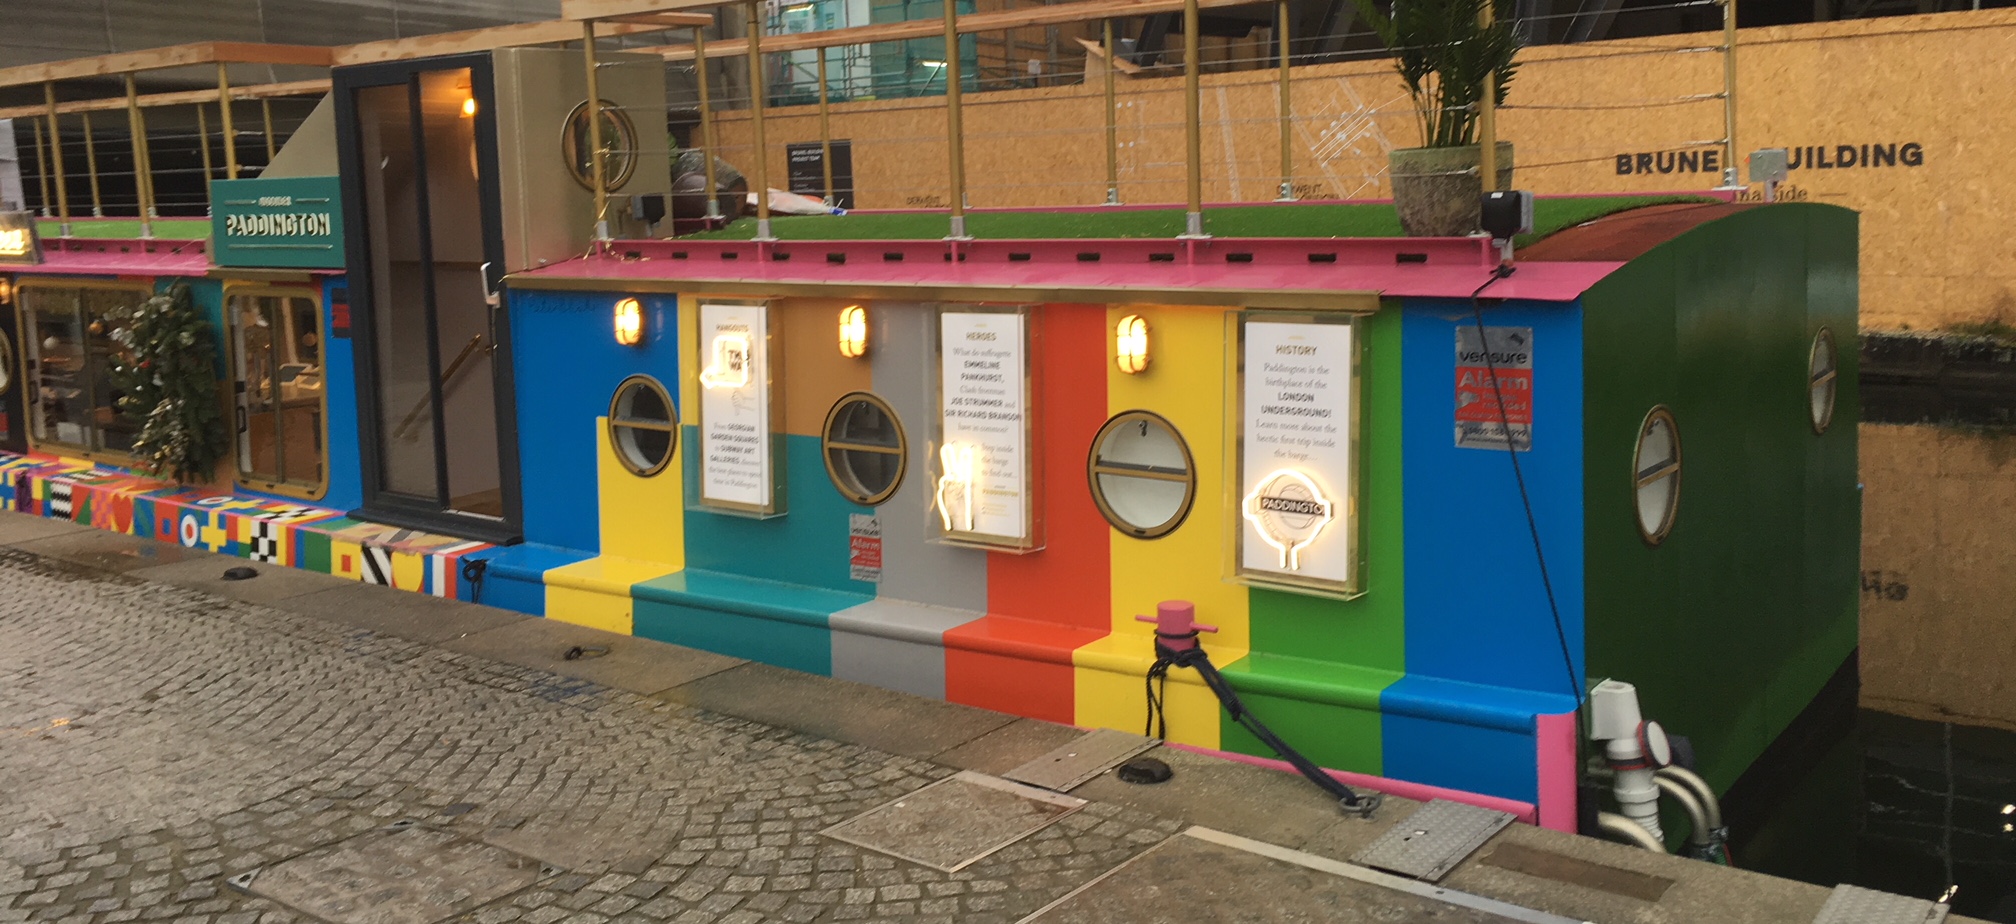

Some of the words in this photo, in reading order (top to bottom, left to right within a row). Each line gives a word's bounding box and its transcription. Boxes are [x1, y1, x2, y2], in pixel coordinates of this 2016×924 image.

[1615, 150, 1721, 175] BRUNE
[1759, 142, 1924, 169] UILDING
[226, 212, 331, 236] PADDINGTON
[966, 331, 998, 341] HEROES
[1275, 345, 1318, 356] HISTORY
[963, 360, 1001, 370] EMMELINE
[1264, 362, 1307, 375] Paddington
[1316, 365, 1330, 375] the
[1264, 377, 1303, 389] birthplace
[1315, 379, 1328, 389] the
[1459, 370, 1529, 390] Alarm
[1277, 391, 1315, 402] LONDON
[944, 408, 956, 418] SIR
[957, 409, 987, 420] RICHARD
[987, 411, 1022, 422] BRANSON
[1260, 404, 1332, 418] UNDERGROUND!
[1256, 418, 1279, 429] Learn
[1279, 423, 1299, 431] more
[1300, 422, 1322, 432] about
[1323, 424, 1337, 433] the
[1262, 498, 1326, 516] PADDINGTO
